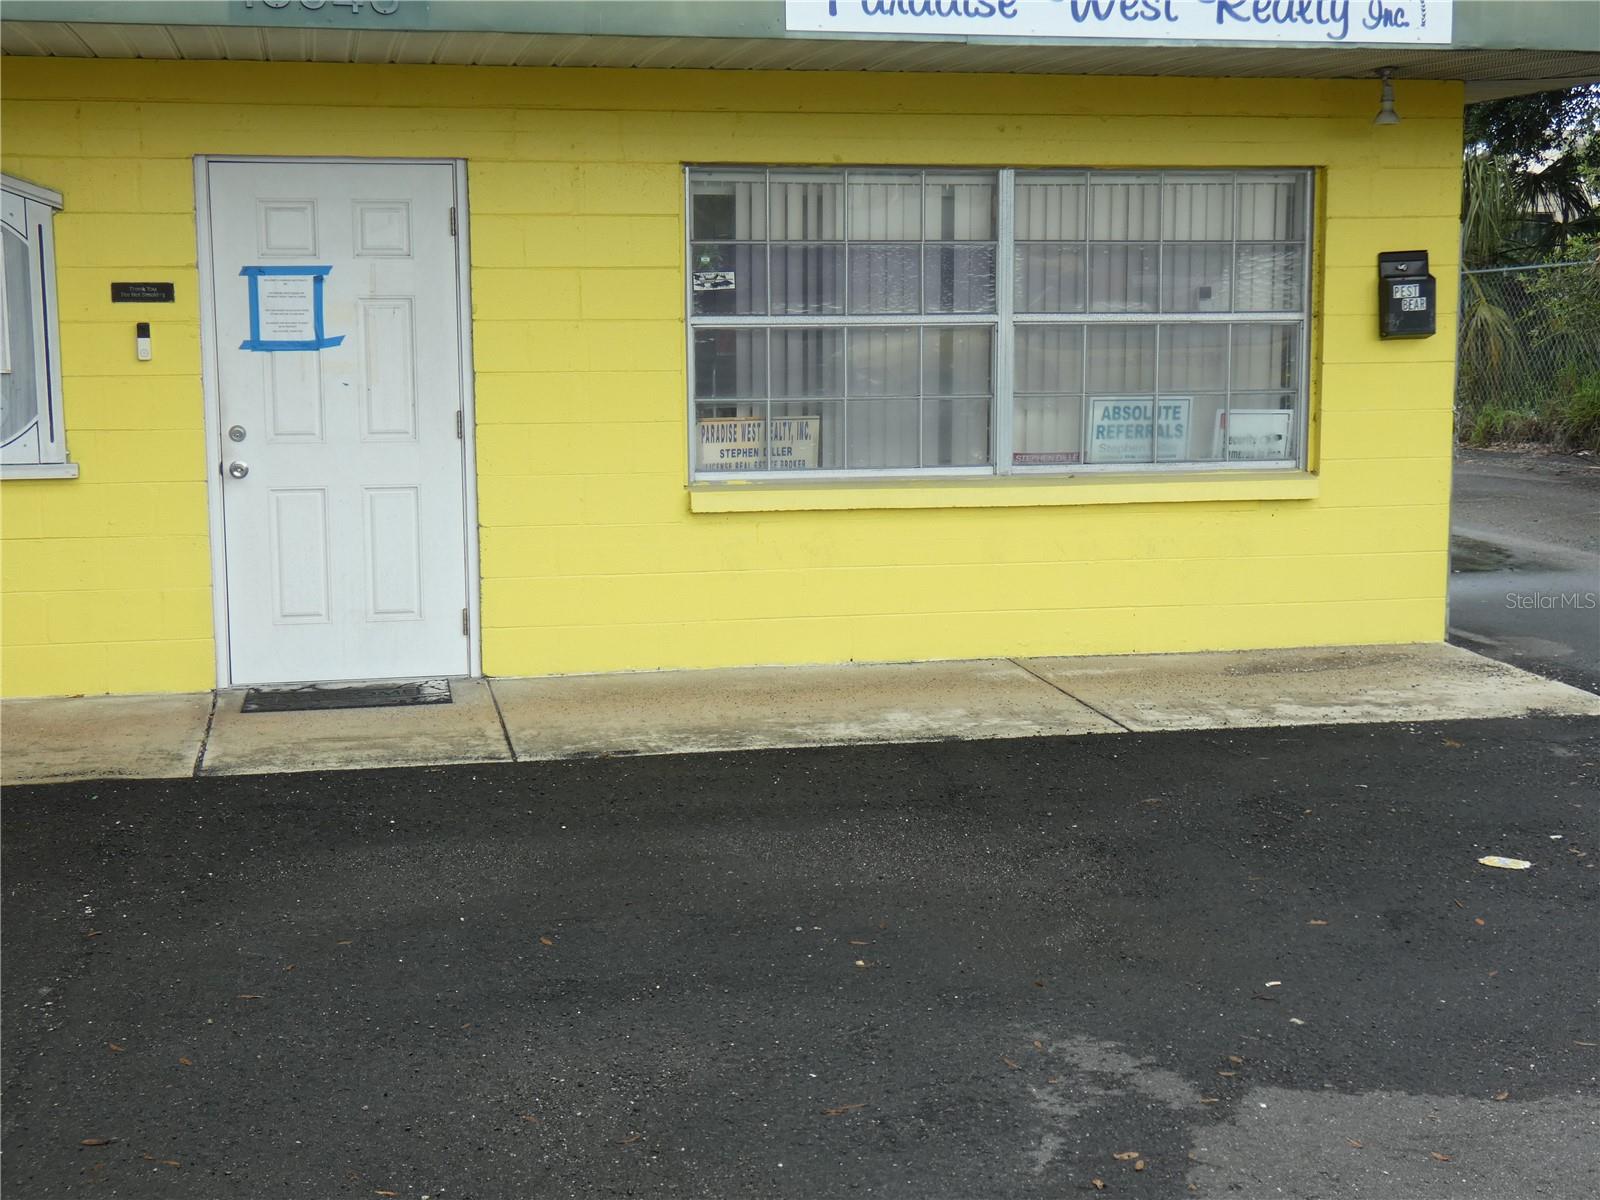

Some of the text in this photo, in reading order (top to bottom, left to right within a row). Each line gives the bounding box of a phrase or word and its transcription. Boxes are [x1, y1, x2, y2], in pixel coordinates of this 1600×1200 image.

[1362, 0, 1410, 30] Inc.
[1394, 285, 1419, 297] PEST
[1402, 298, 1425, 311] BEAR
[701, 423, 738, 443] PARADISE
[740, 422, 761, 442] WEST
[796, 421, 812, 441] INC.
[1096, 423, 1184, 440] REFERRALS
[719, 446, 793, 458] STEPHEN DLLER
[754, 460, 777, 468] ESTTE
